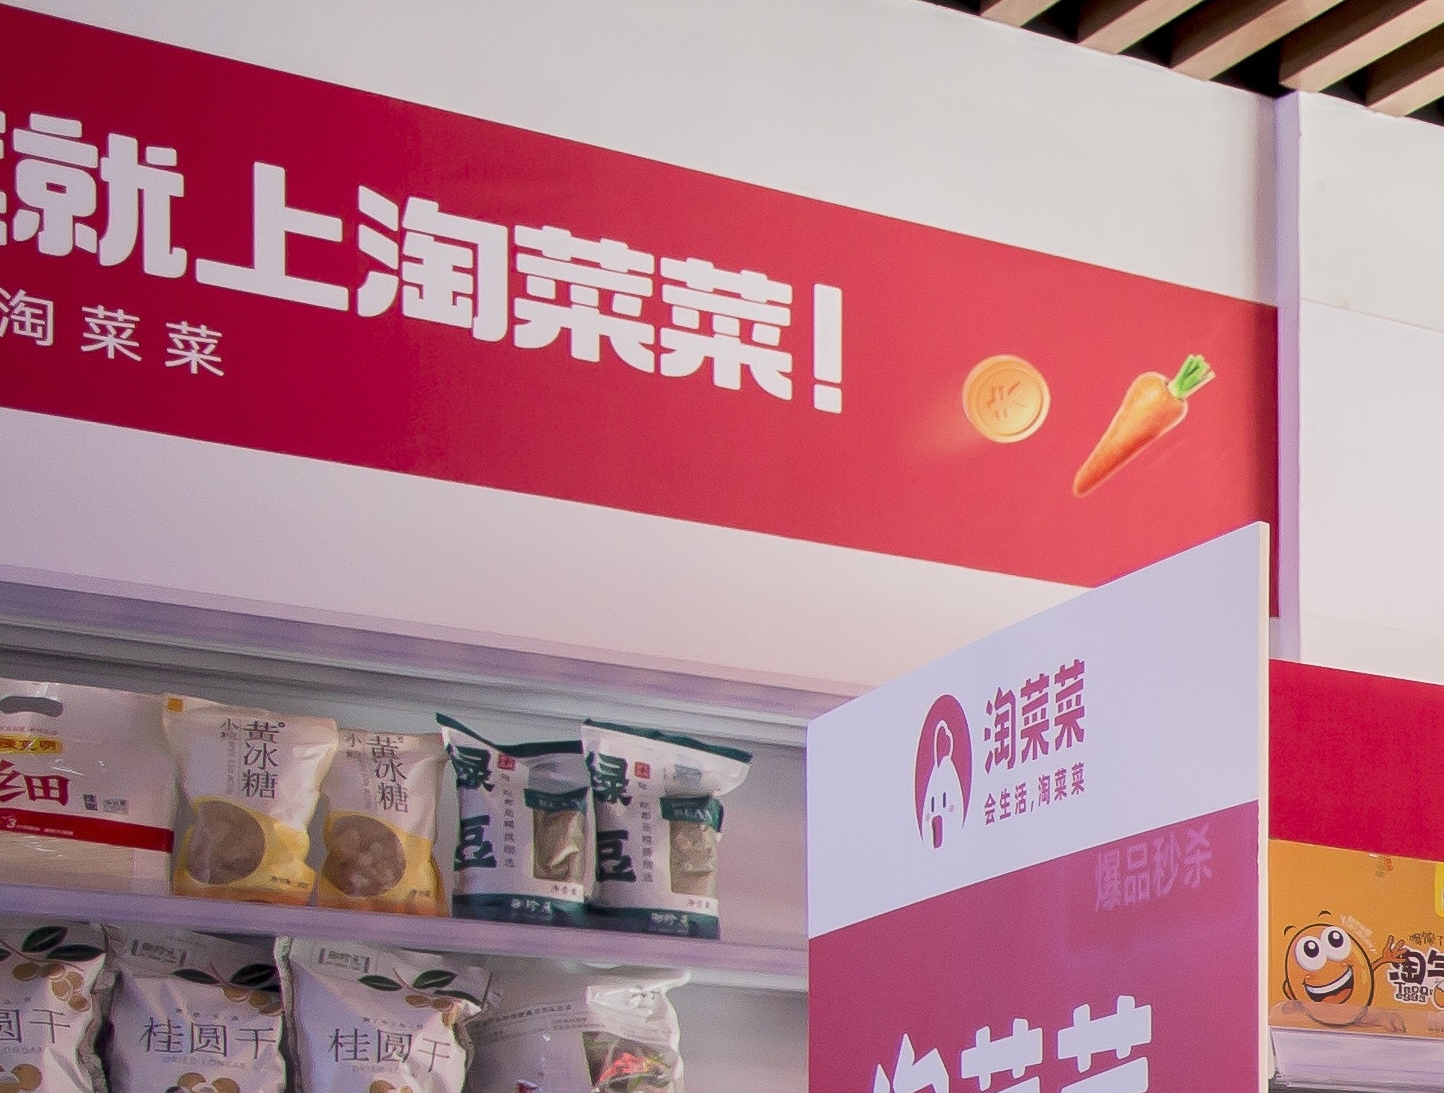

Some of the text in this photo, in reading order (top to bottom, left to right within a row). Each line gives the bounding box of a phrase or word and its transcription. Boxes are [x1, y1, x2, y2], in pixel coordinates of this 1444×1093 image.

[0, 112, 843, 414] 就上淘菜菜!
[0, 288, 225, 377] 淘菜菜
[984, 659, 1085, 774] 淘菜菜
[241, 720, 281, 800] 黄冰糖
[367, 735, 410, 815] 黄冰糖
[984, 762, 1085, 825] 会生活,淘菜菜
[138, 1015, 277, 1060] 桂圆干
[328, 1027, 451, 1073] 桂圆干
